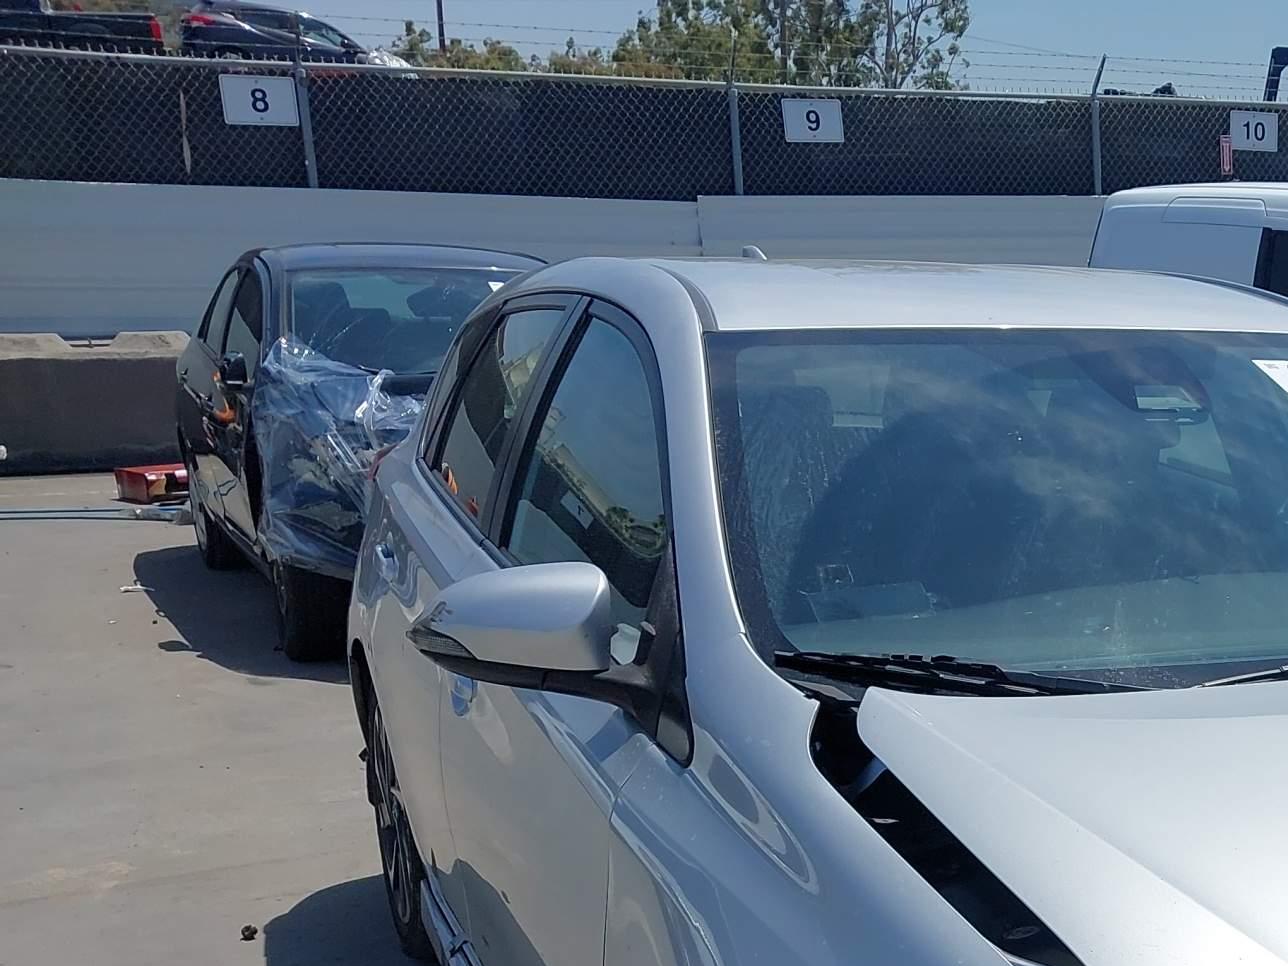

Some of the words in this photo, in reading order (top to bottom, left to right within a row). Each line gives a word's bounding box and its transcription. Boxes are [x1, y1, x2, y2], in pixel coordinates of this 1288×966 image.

[250, 87, 270, 113] 8
[805, 109, 821, 132] 9
[1242, 120, 1266, 142] 10
